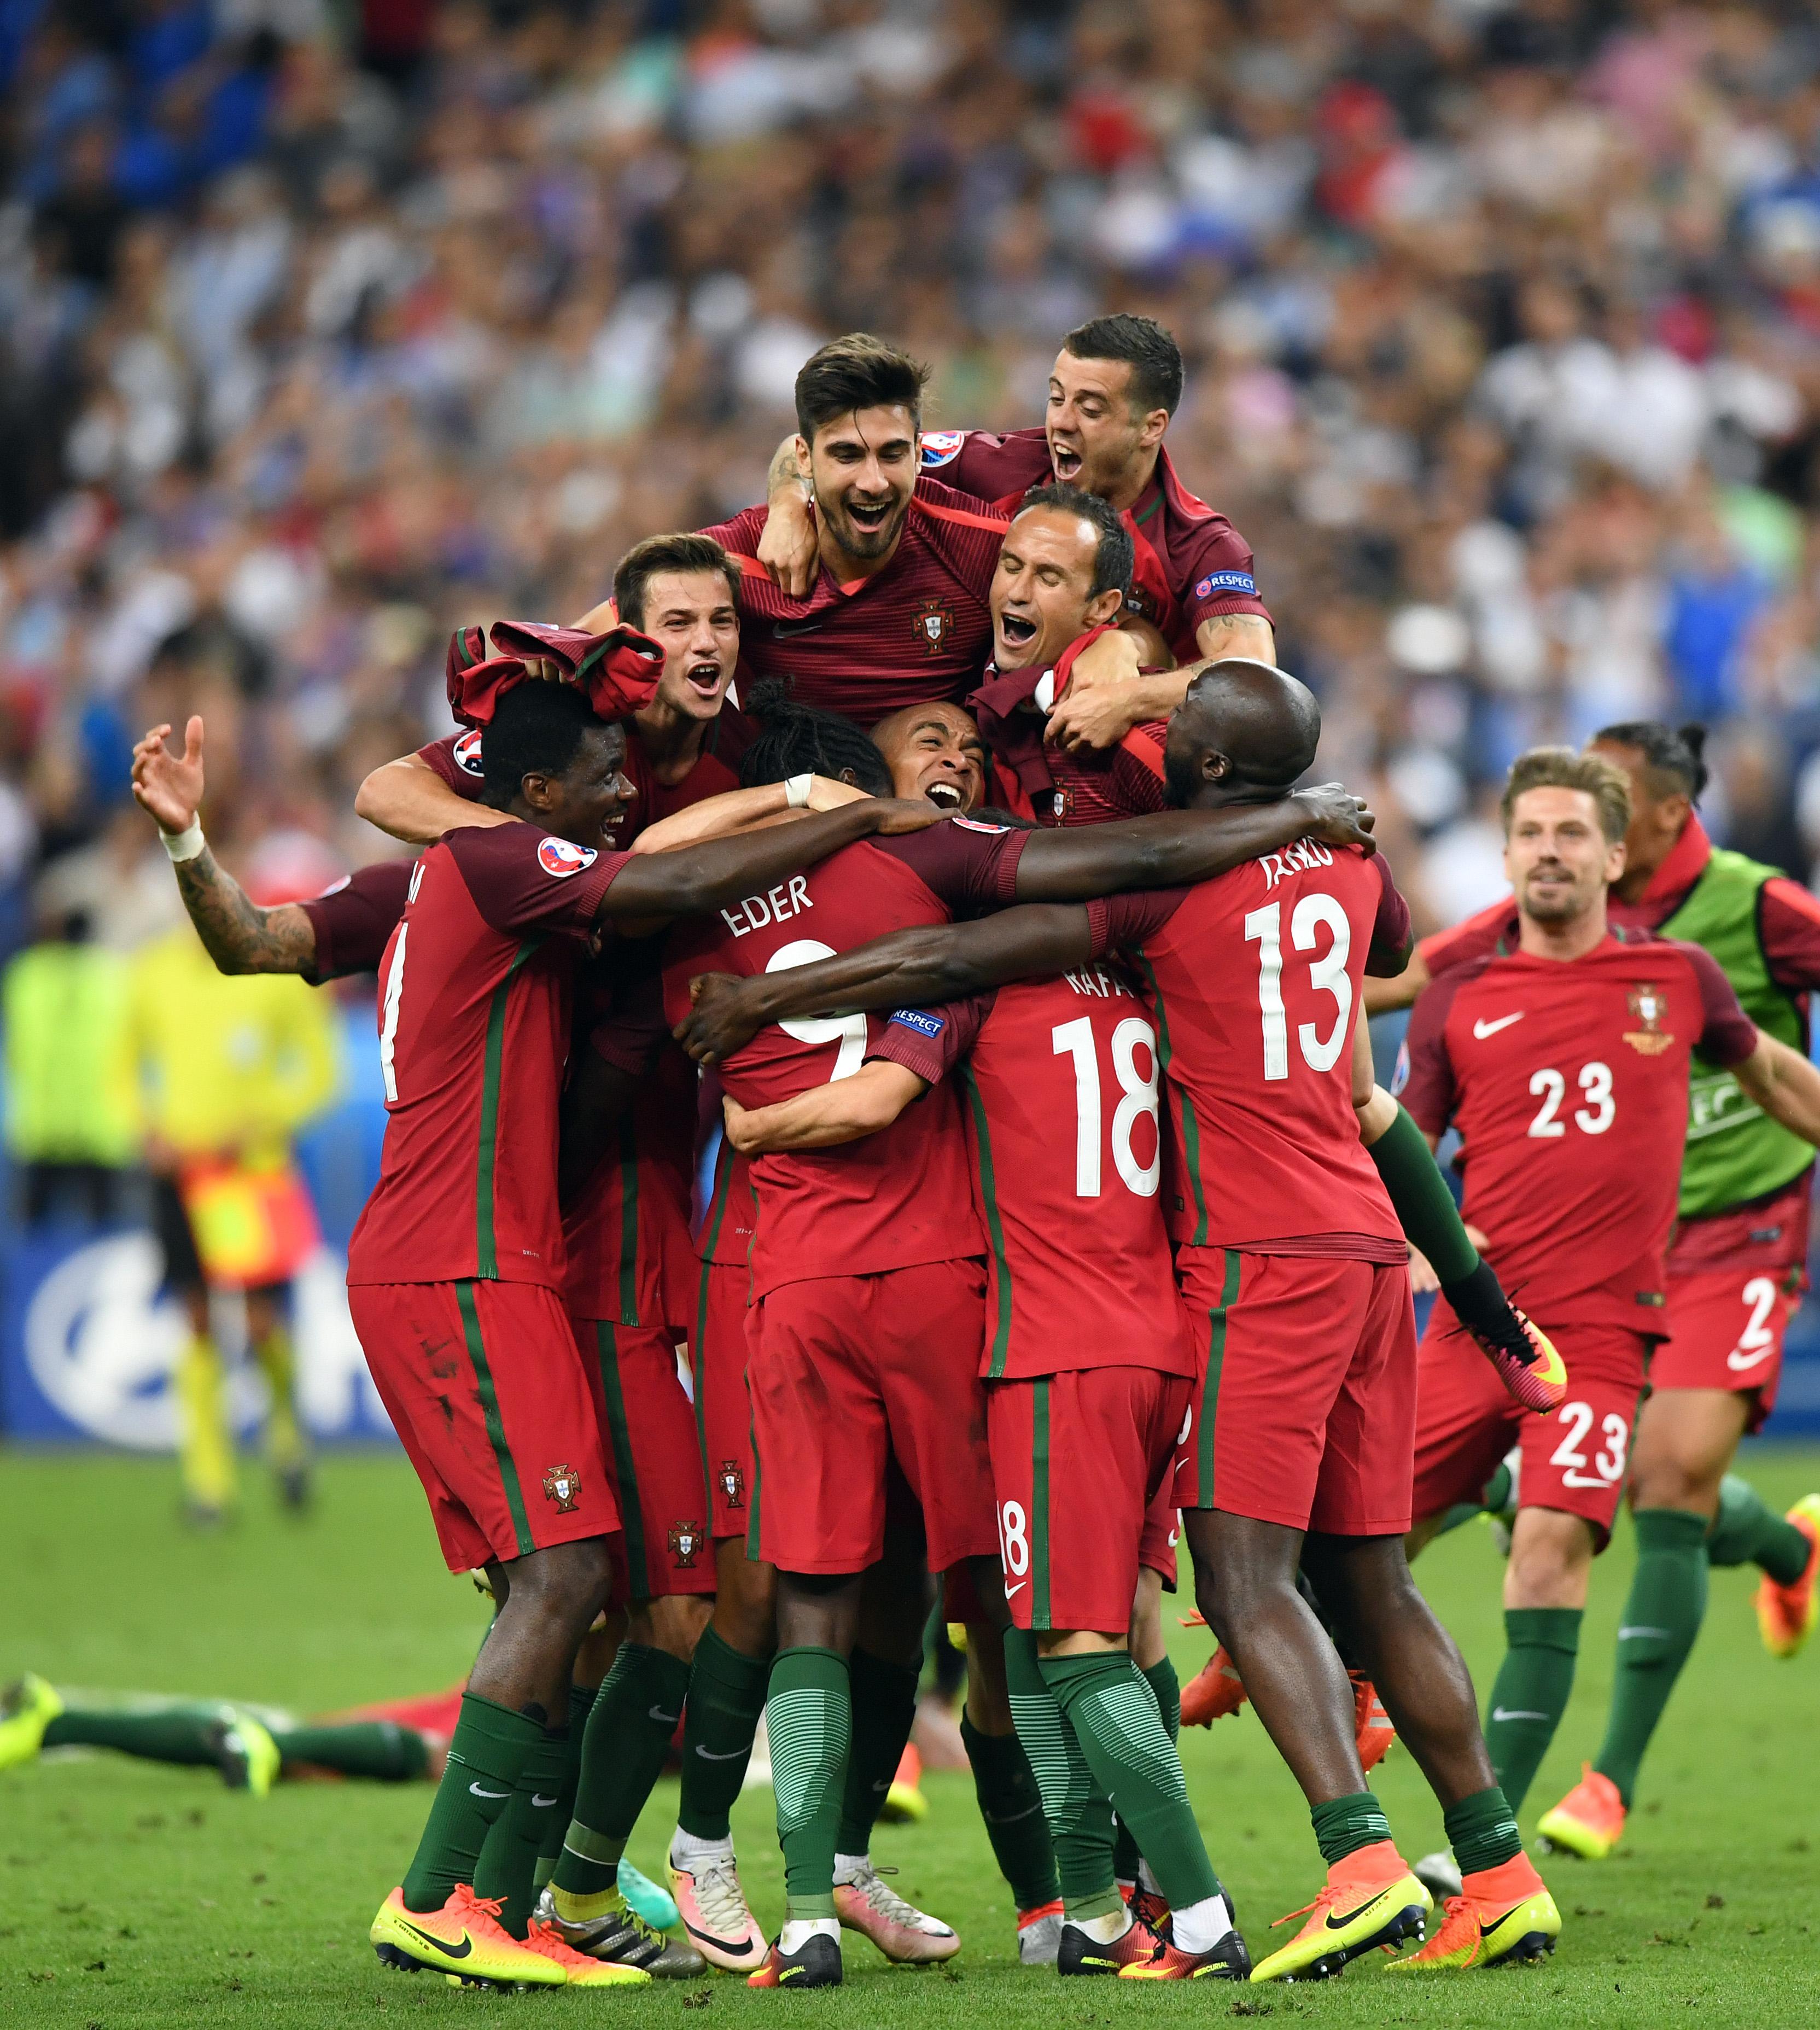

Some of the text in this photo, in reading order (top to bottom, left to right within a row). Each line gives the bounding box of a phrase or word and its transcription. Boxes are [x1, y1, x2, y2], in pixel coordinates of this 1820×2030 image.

[1211, 575, 1253, 589] RESPECT
[720, 876, 814, 938] EDER
[894, 1009, 941, 1032] RESPECT
[1244, 893, 1352, 1081] 13
[1052, 1016, 1160, 1198] 18
[1527, 1061, 1616, 1138] 23
[1737, 1277, 1776, 1350] 2
[1549, 1401, 1629, 1481] 23
